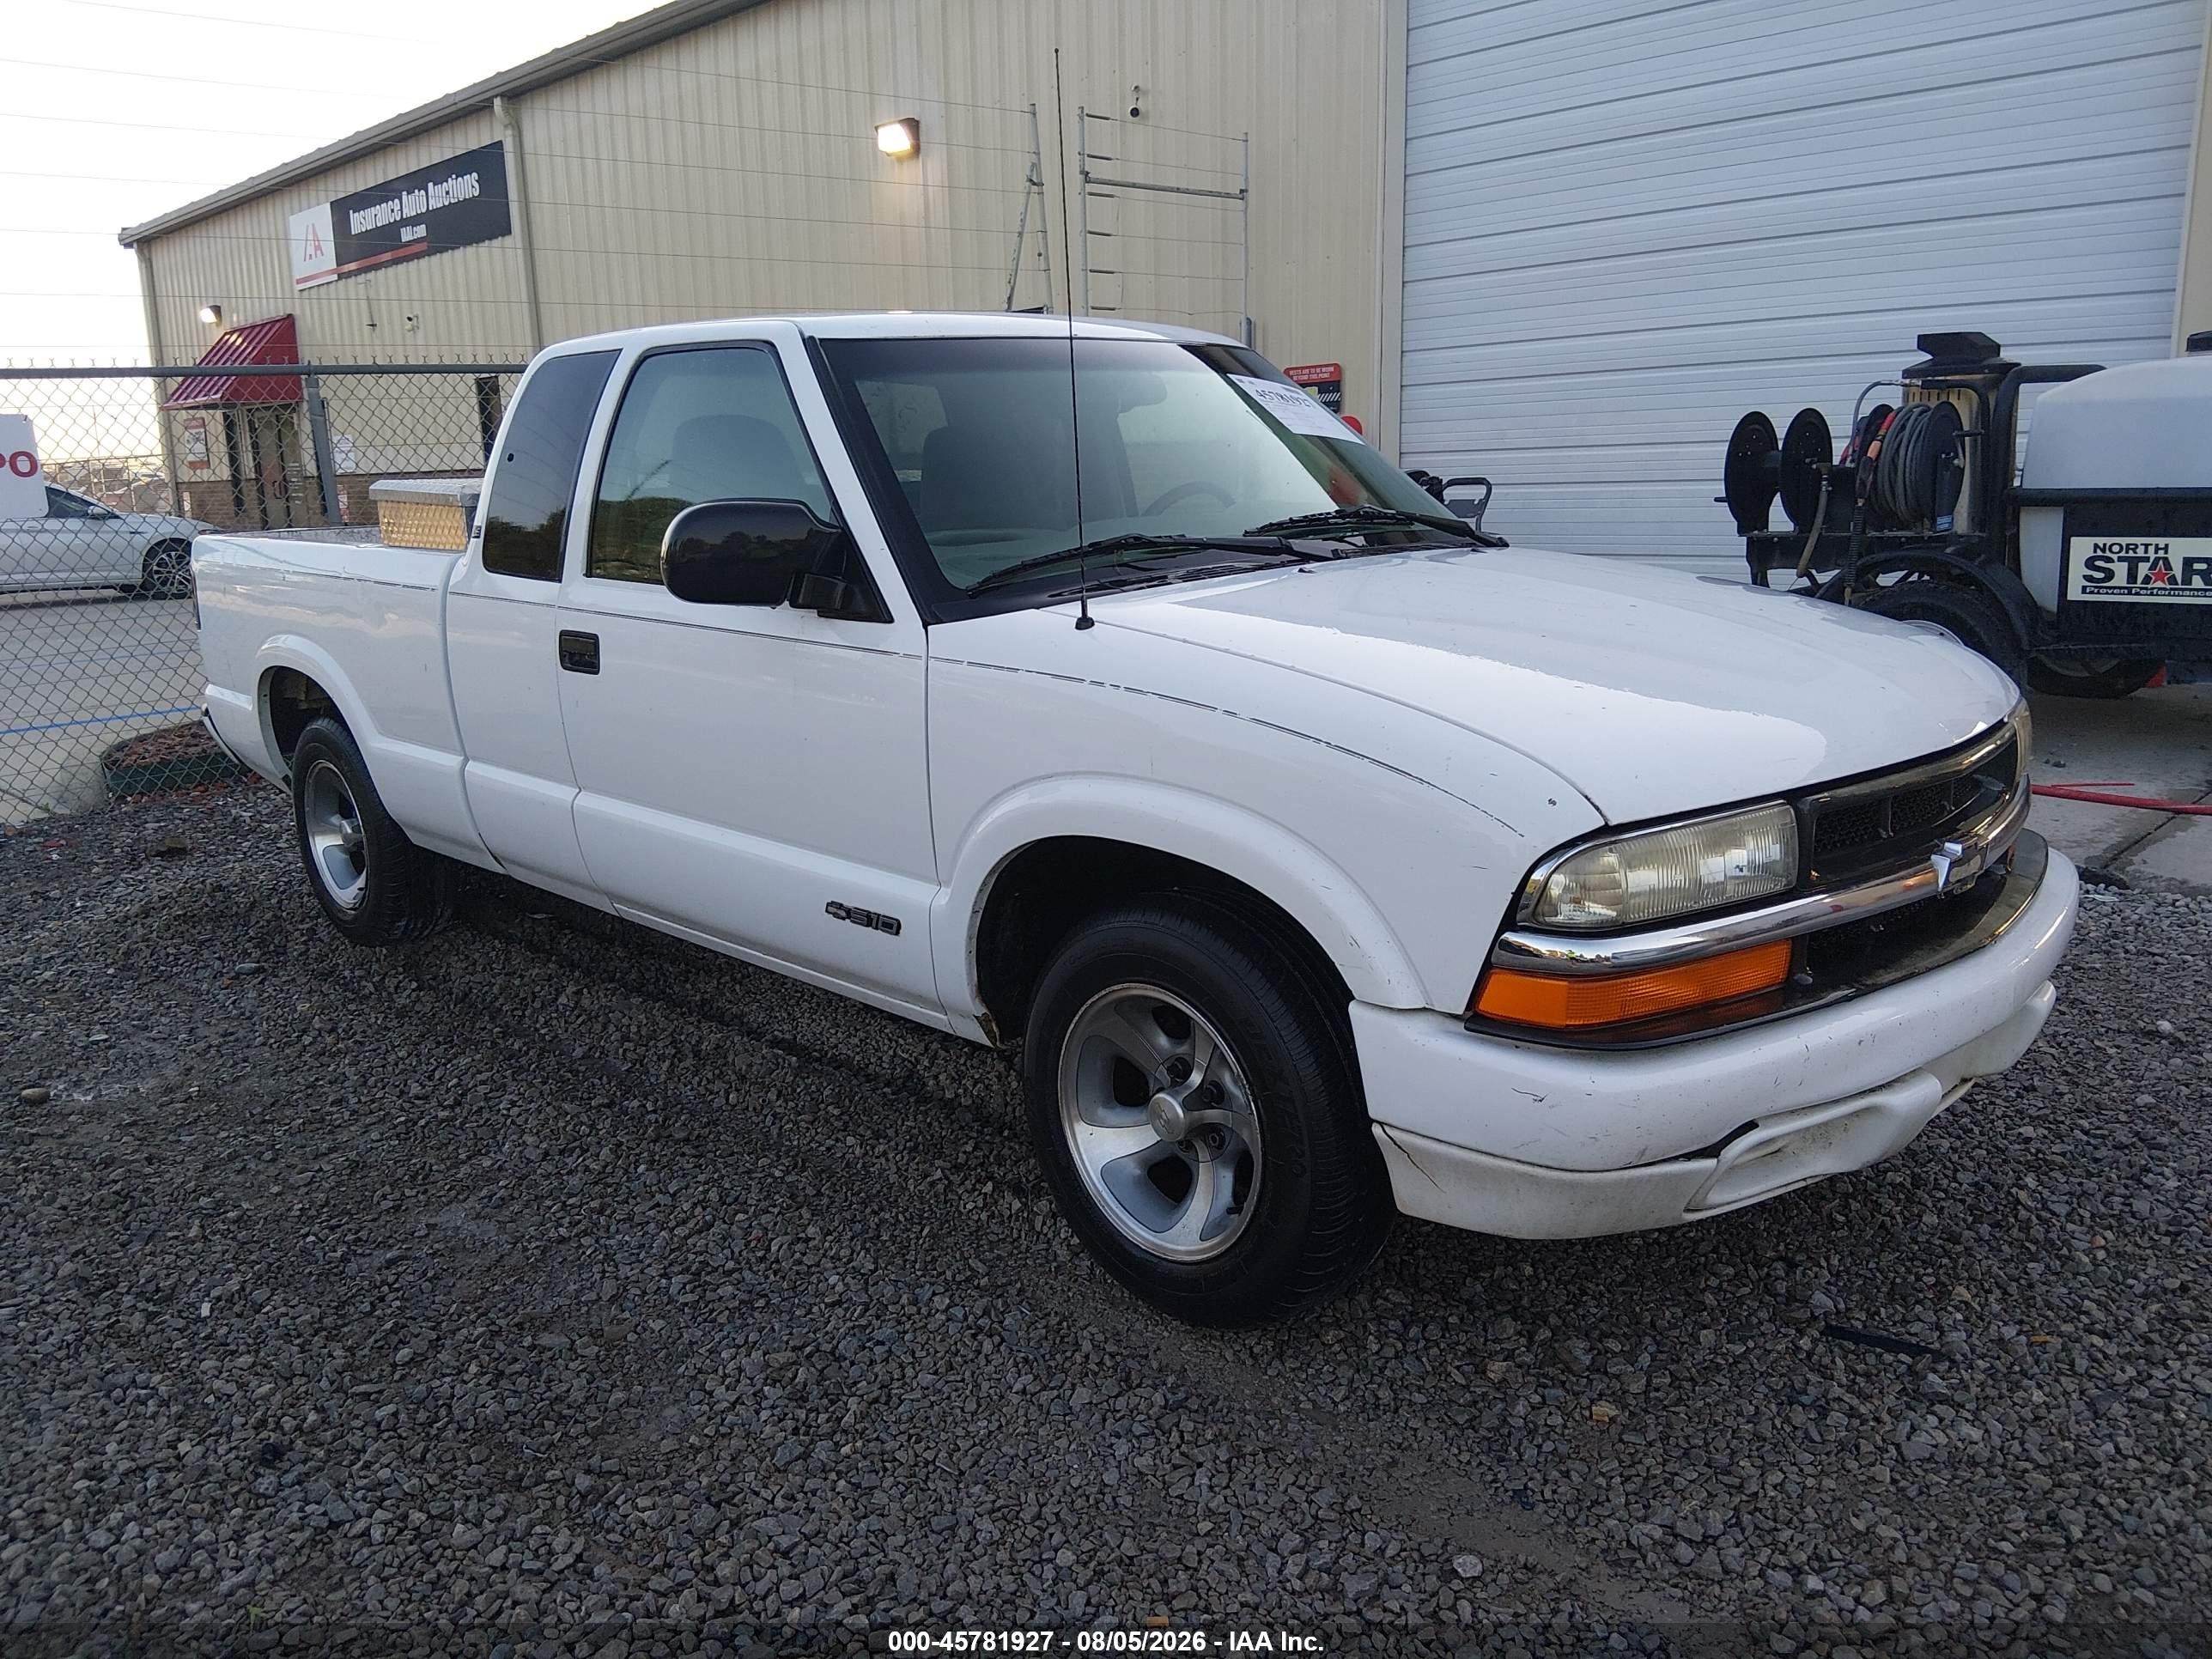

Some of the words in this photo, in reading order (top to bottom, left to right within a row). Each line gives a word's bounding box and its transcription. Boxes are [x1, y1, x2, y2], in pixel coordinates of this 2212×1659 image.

[349, 198, 401, 235] Insurance
[402, 188, 427, 219] Auto
[428, 172, 480, 211] Auctions
[2093, 542, 2169, 555] NORTH
[2081, 554, 2212, 586] STAR
[2131, 587, 2212, 597] Performance
[849, 907, 902, 936] S10
